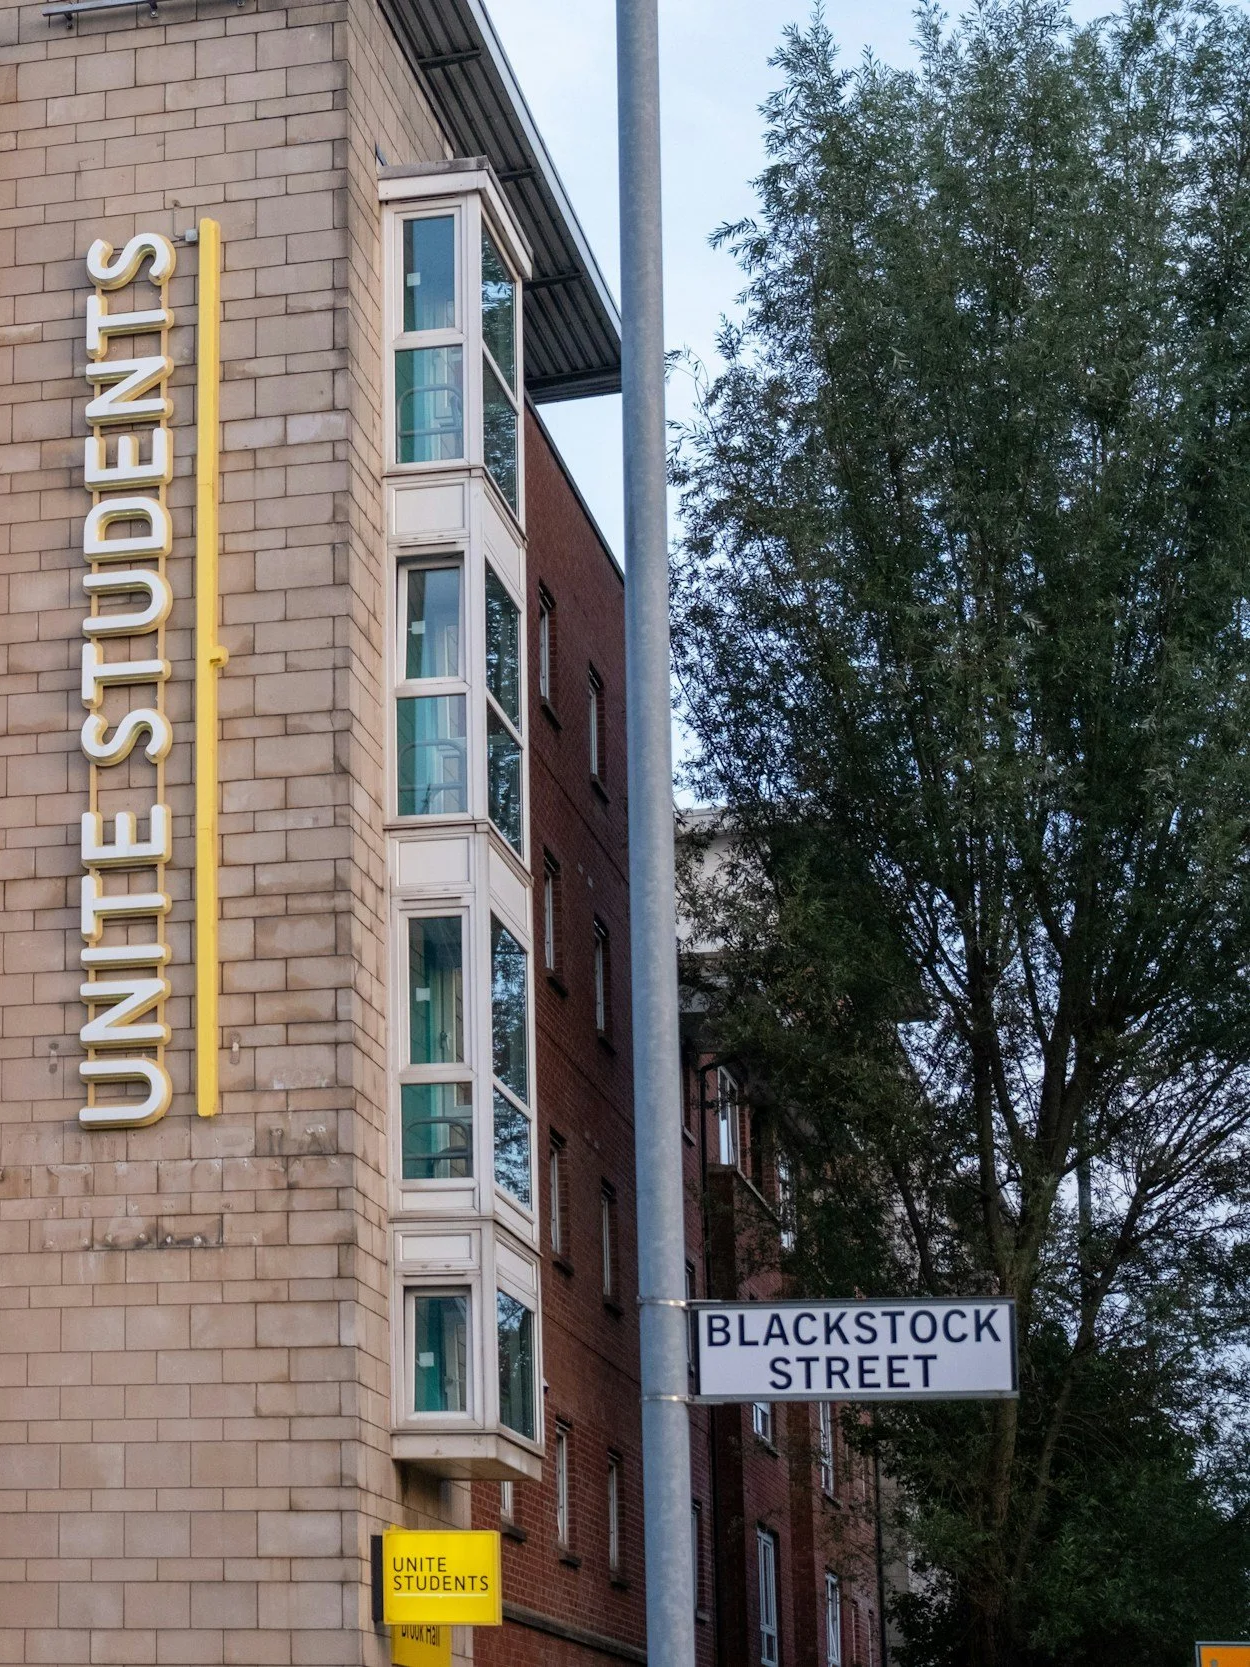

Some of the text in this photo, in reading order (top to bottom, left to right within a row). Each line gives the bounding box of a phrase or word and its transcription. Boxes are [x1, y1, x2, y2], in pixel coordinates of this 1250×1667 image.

[81, 232, 176, 766] STUDENTS
[79, 804, 172, 1129] UNITE
[706, 1308, 1001, 1347] BLACKSTOCK
[768, 1354, 938, 1390] STREET
[393, 1557, 447, 1572] UNITE
[393, 1575, 489, 1591] STUDENTS
